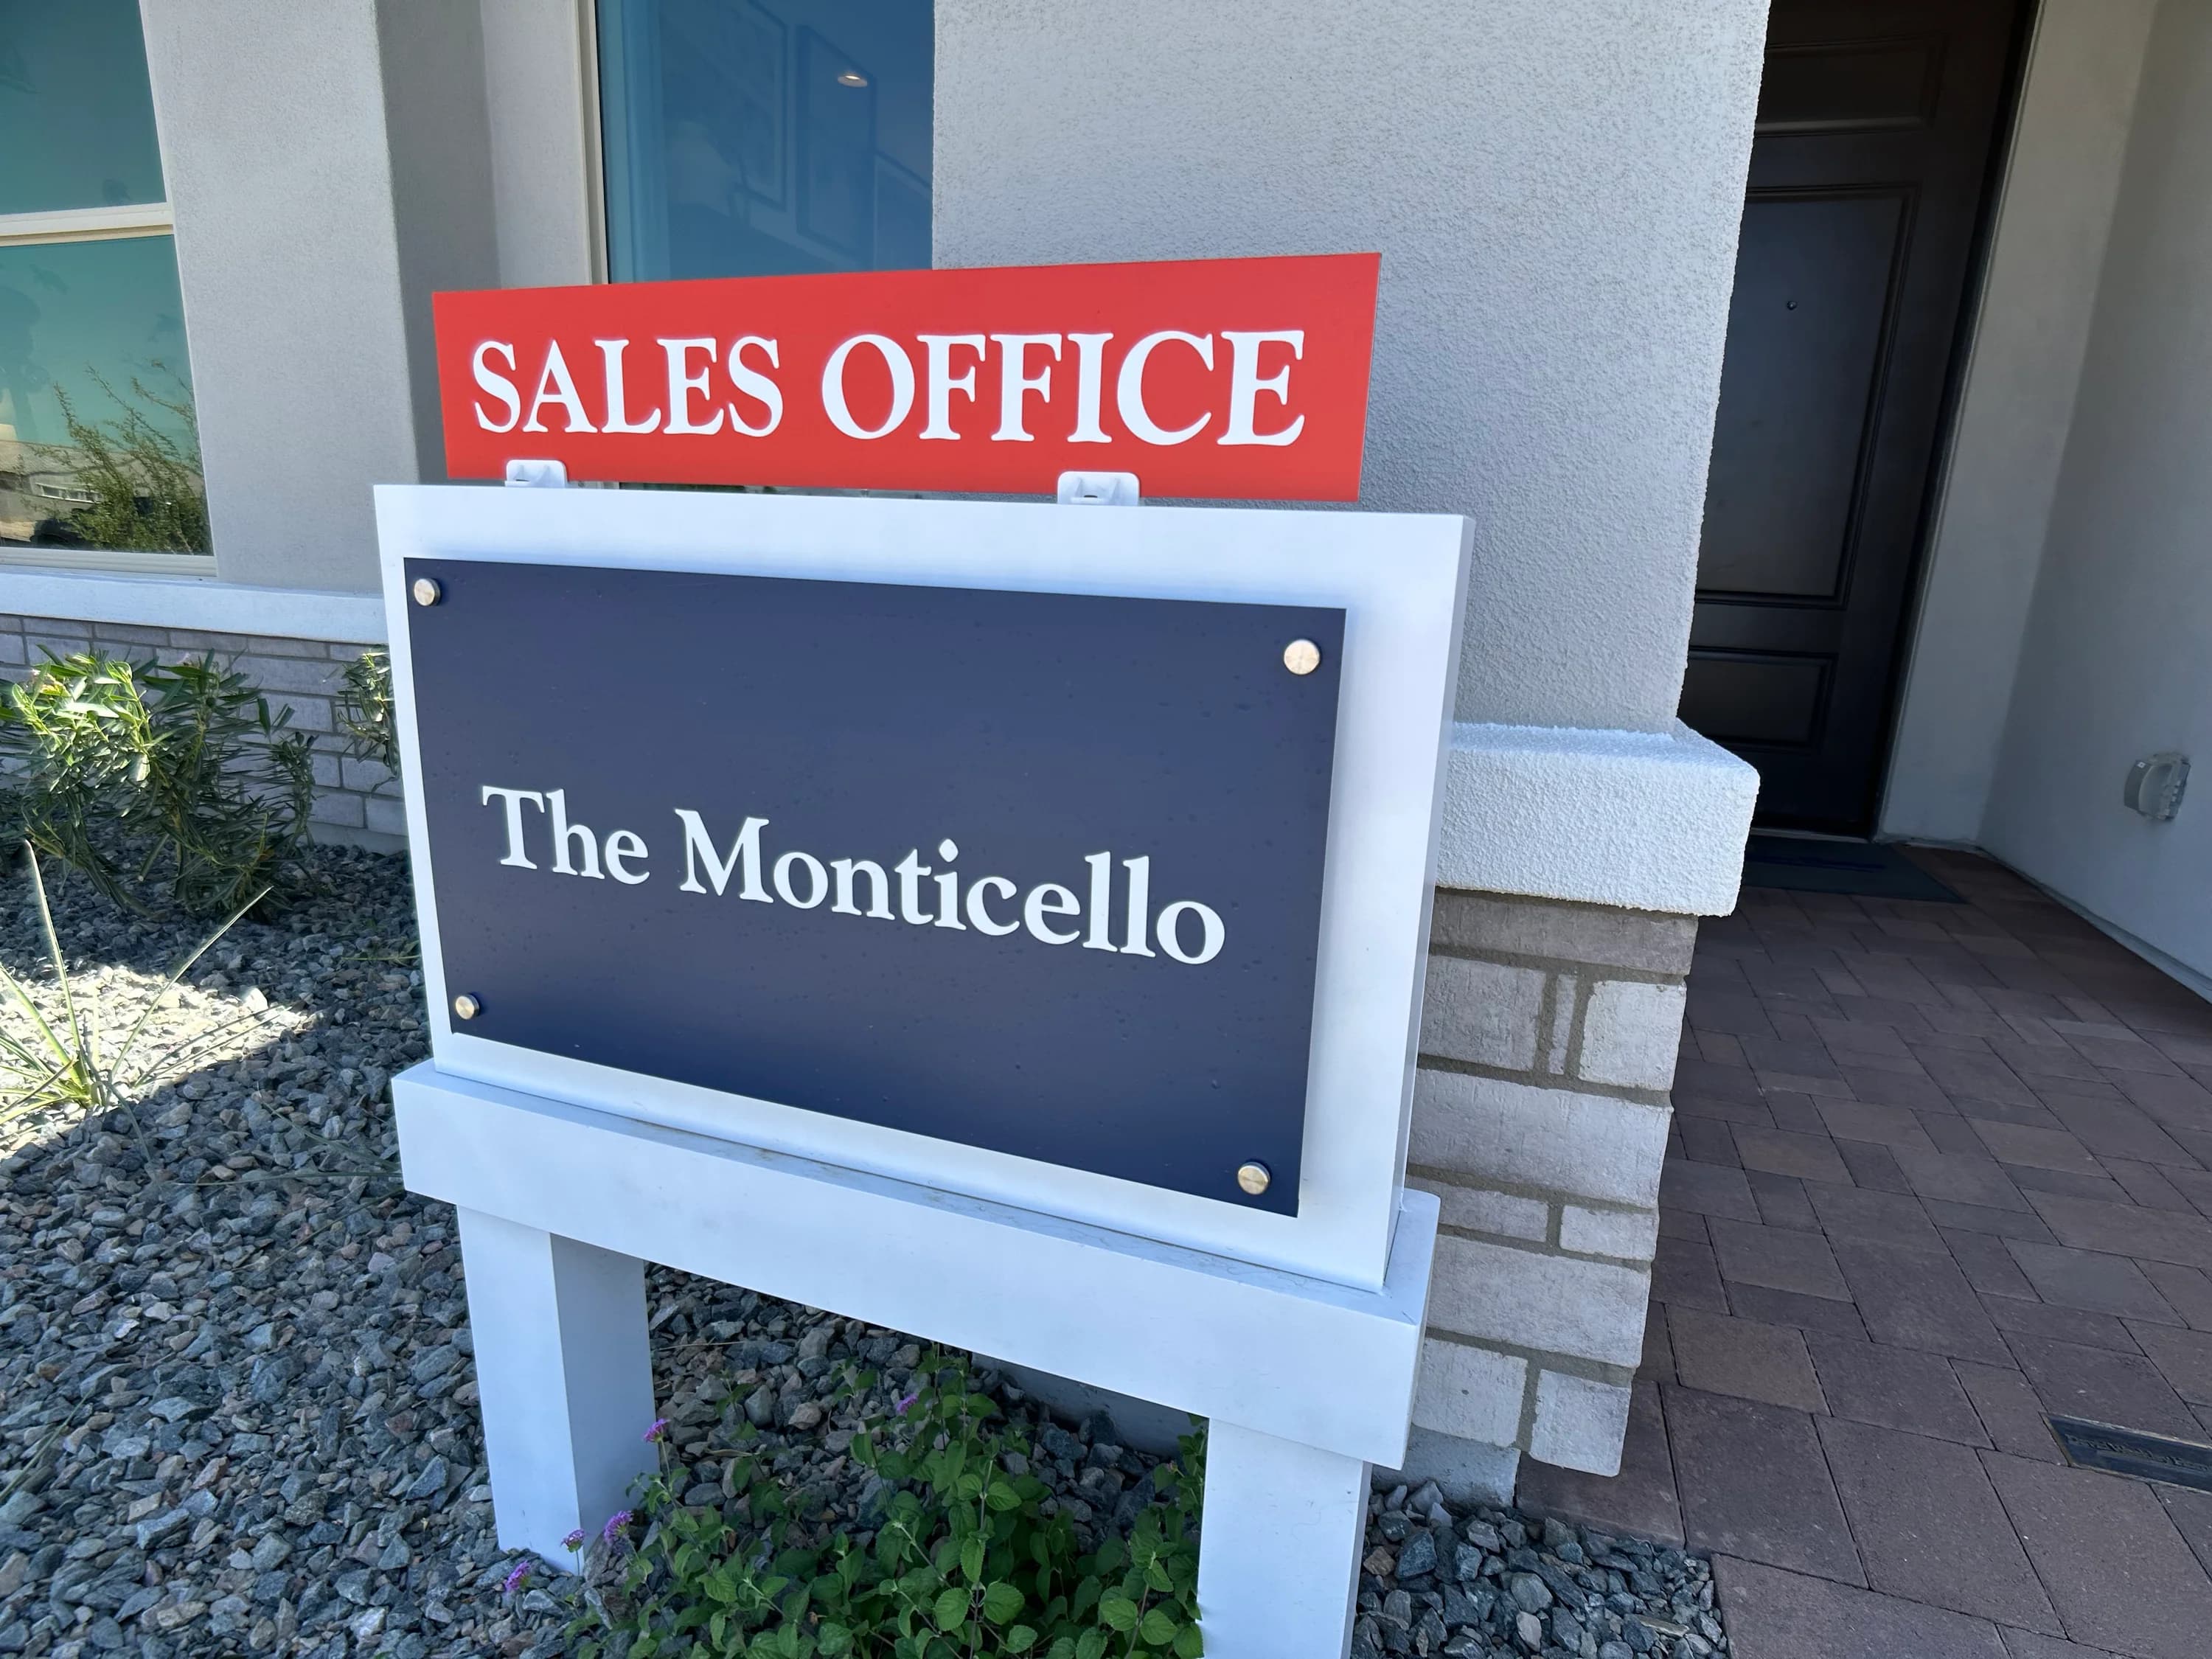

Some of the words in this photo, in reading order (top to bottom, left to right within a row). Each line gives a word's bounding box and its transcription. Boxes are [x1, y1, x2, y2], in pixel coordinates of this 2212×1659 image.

[472, 335, 784, 437] SALES
[821, 330, 1305, 446] OFFICE
[481, 785, 650, 885] The
[675, 808, 1225, 964] Monticello
